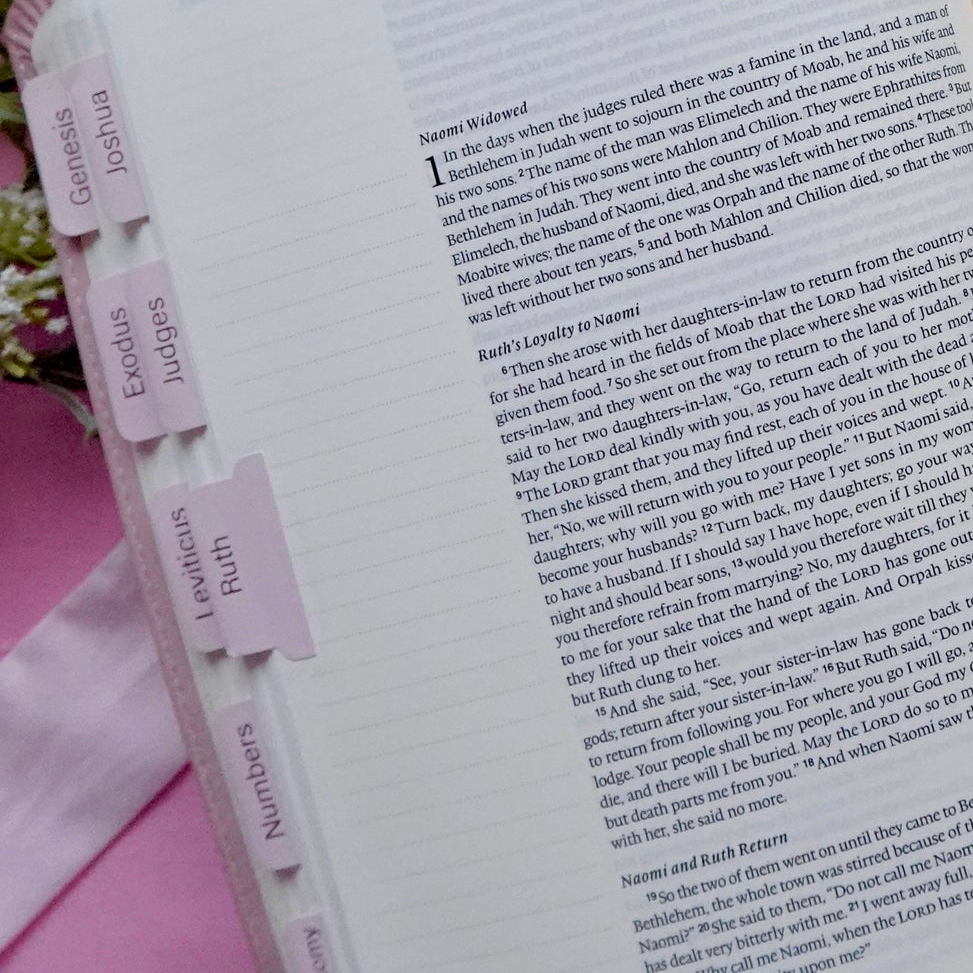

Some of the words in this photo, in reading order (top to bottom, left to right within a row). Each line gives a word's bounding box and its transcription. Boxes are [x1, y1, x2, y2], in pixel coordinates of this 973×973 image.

[419, 120, 464, 146] Naomi
[466, 100, 529, 131] Widowed
[442, 150, 458, 163] In
[461, 142, 483, 157] the
[486, 133, 515, 150] days
[517, 121, 555, 139] when
[557, 113, 580, 128] the
[582, 98, 627, 123] judges
[630, 83, 667, 106] ruled
[669, 75, 705, 94] there
[707, 67, 734, 82] was
[737, 63, 746, 74] a
[748, 48, 797, 71] famine
[799, 42, 815, 56] in
[817, 36, 840, 50] the
[841, 24, 876, 44] land,
[878, 16, 903, 34] and
[904, 17, 913, 27] a
[912, 10, 939, 25] man
[939, 4, 949, 18] of
[52, 108, 92, 206] Genesis
[91, 90, 128, 175] Joshua
[425, 155, 446, 188] 1
[468, 310, 493, 325] was
[493, 300, 518, 318] left
[518, 286, 572, 310] without
[572, 279, 596, 295] her
[598, 271, 624, 287] two
[625, 261, 656, 279] sons
[658, 250, 685, 270] and
[684, 245, 709, 261] her
[710, 224, 774, 253] husband.
[110, 307, 145, 399] Exodus
[148, 297, 184, 384] Judges
[523, 325, 574, 349] Loyalty
[577, 320, 591, 333] to
[593, 302, 641, 329] Naomi
[210, 535, 243, 596] Ruth
[571, 691, 596, 707] but
[598, 680, 633, 700] Ruth
[635, 670, 676, 690] clung
[677, 665, 692, 678] to
[693, 657, 721, 673] her.
[237, 723, 285, 840] Numbers
[621, 864, 668, 888] Naomi
[671, 855, 698, 875] and
[700, 846, 735, 867] Ruth
[738, 833, 788, 856] Return
[633, 906, 710, 933] Bethlehem,
[711, 897, 734, 912] the
[735, 883, 778, 904] whole
[779, 874, 816, 892] town
[817, 865, 844, 881] was
[846, 846, 891, 873] stirred
[891, 832, 946, 858] because
[947, 822, 962, 839] of
